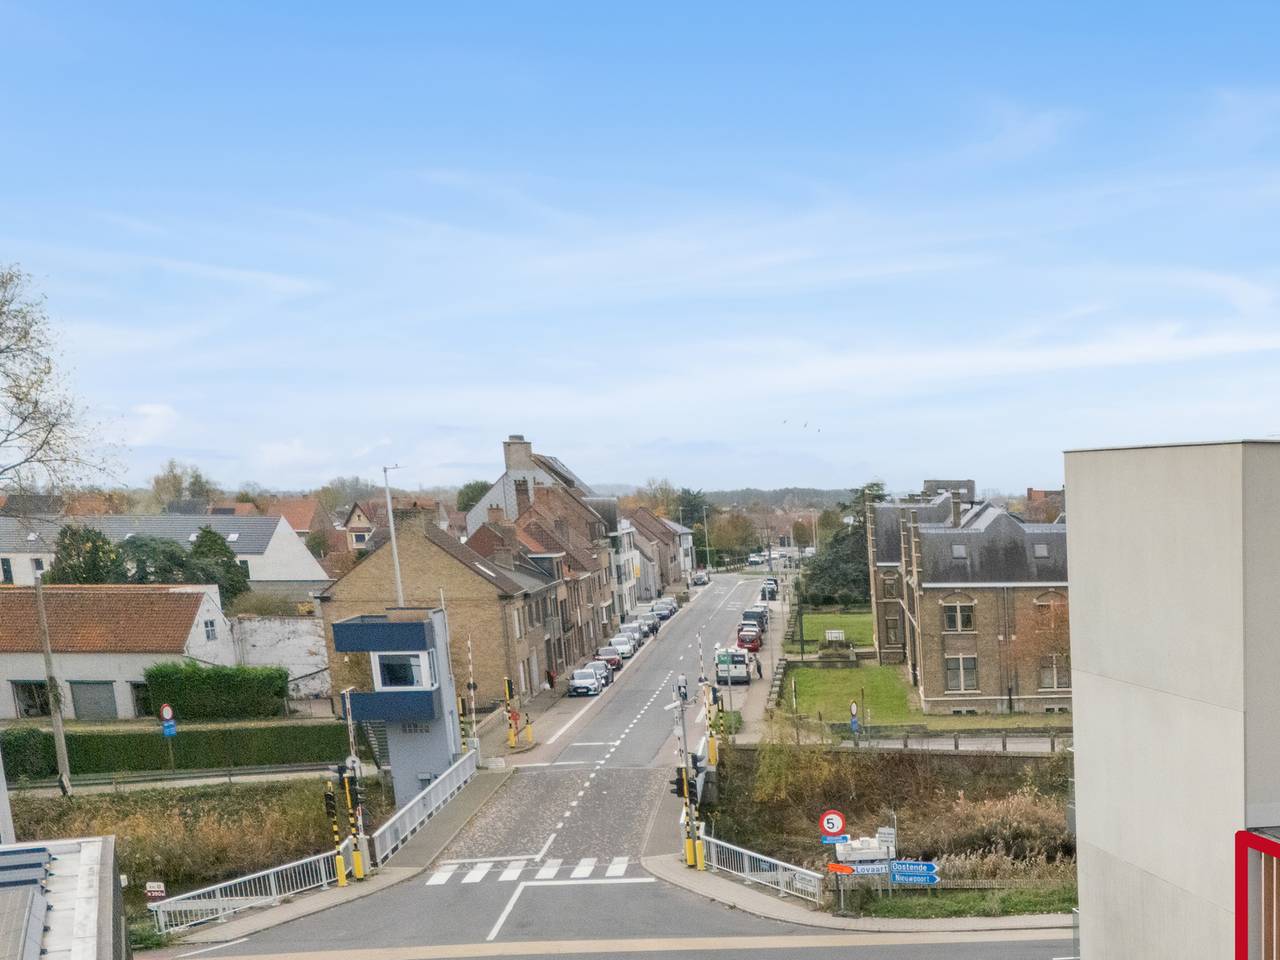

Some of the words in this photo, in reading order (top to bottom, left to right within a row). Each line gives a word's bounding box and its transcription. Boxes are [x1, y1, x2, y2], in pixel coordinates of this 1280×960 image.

[856, 866, 889, 874] Lovaart
[892, 863, 928, 871] Oostende
[895, 874, 930, 883] Nieuwpoort
